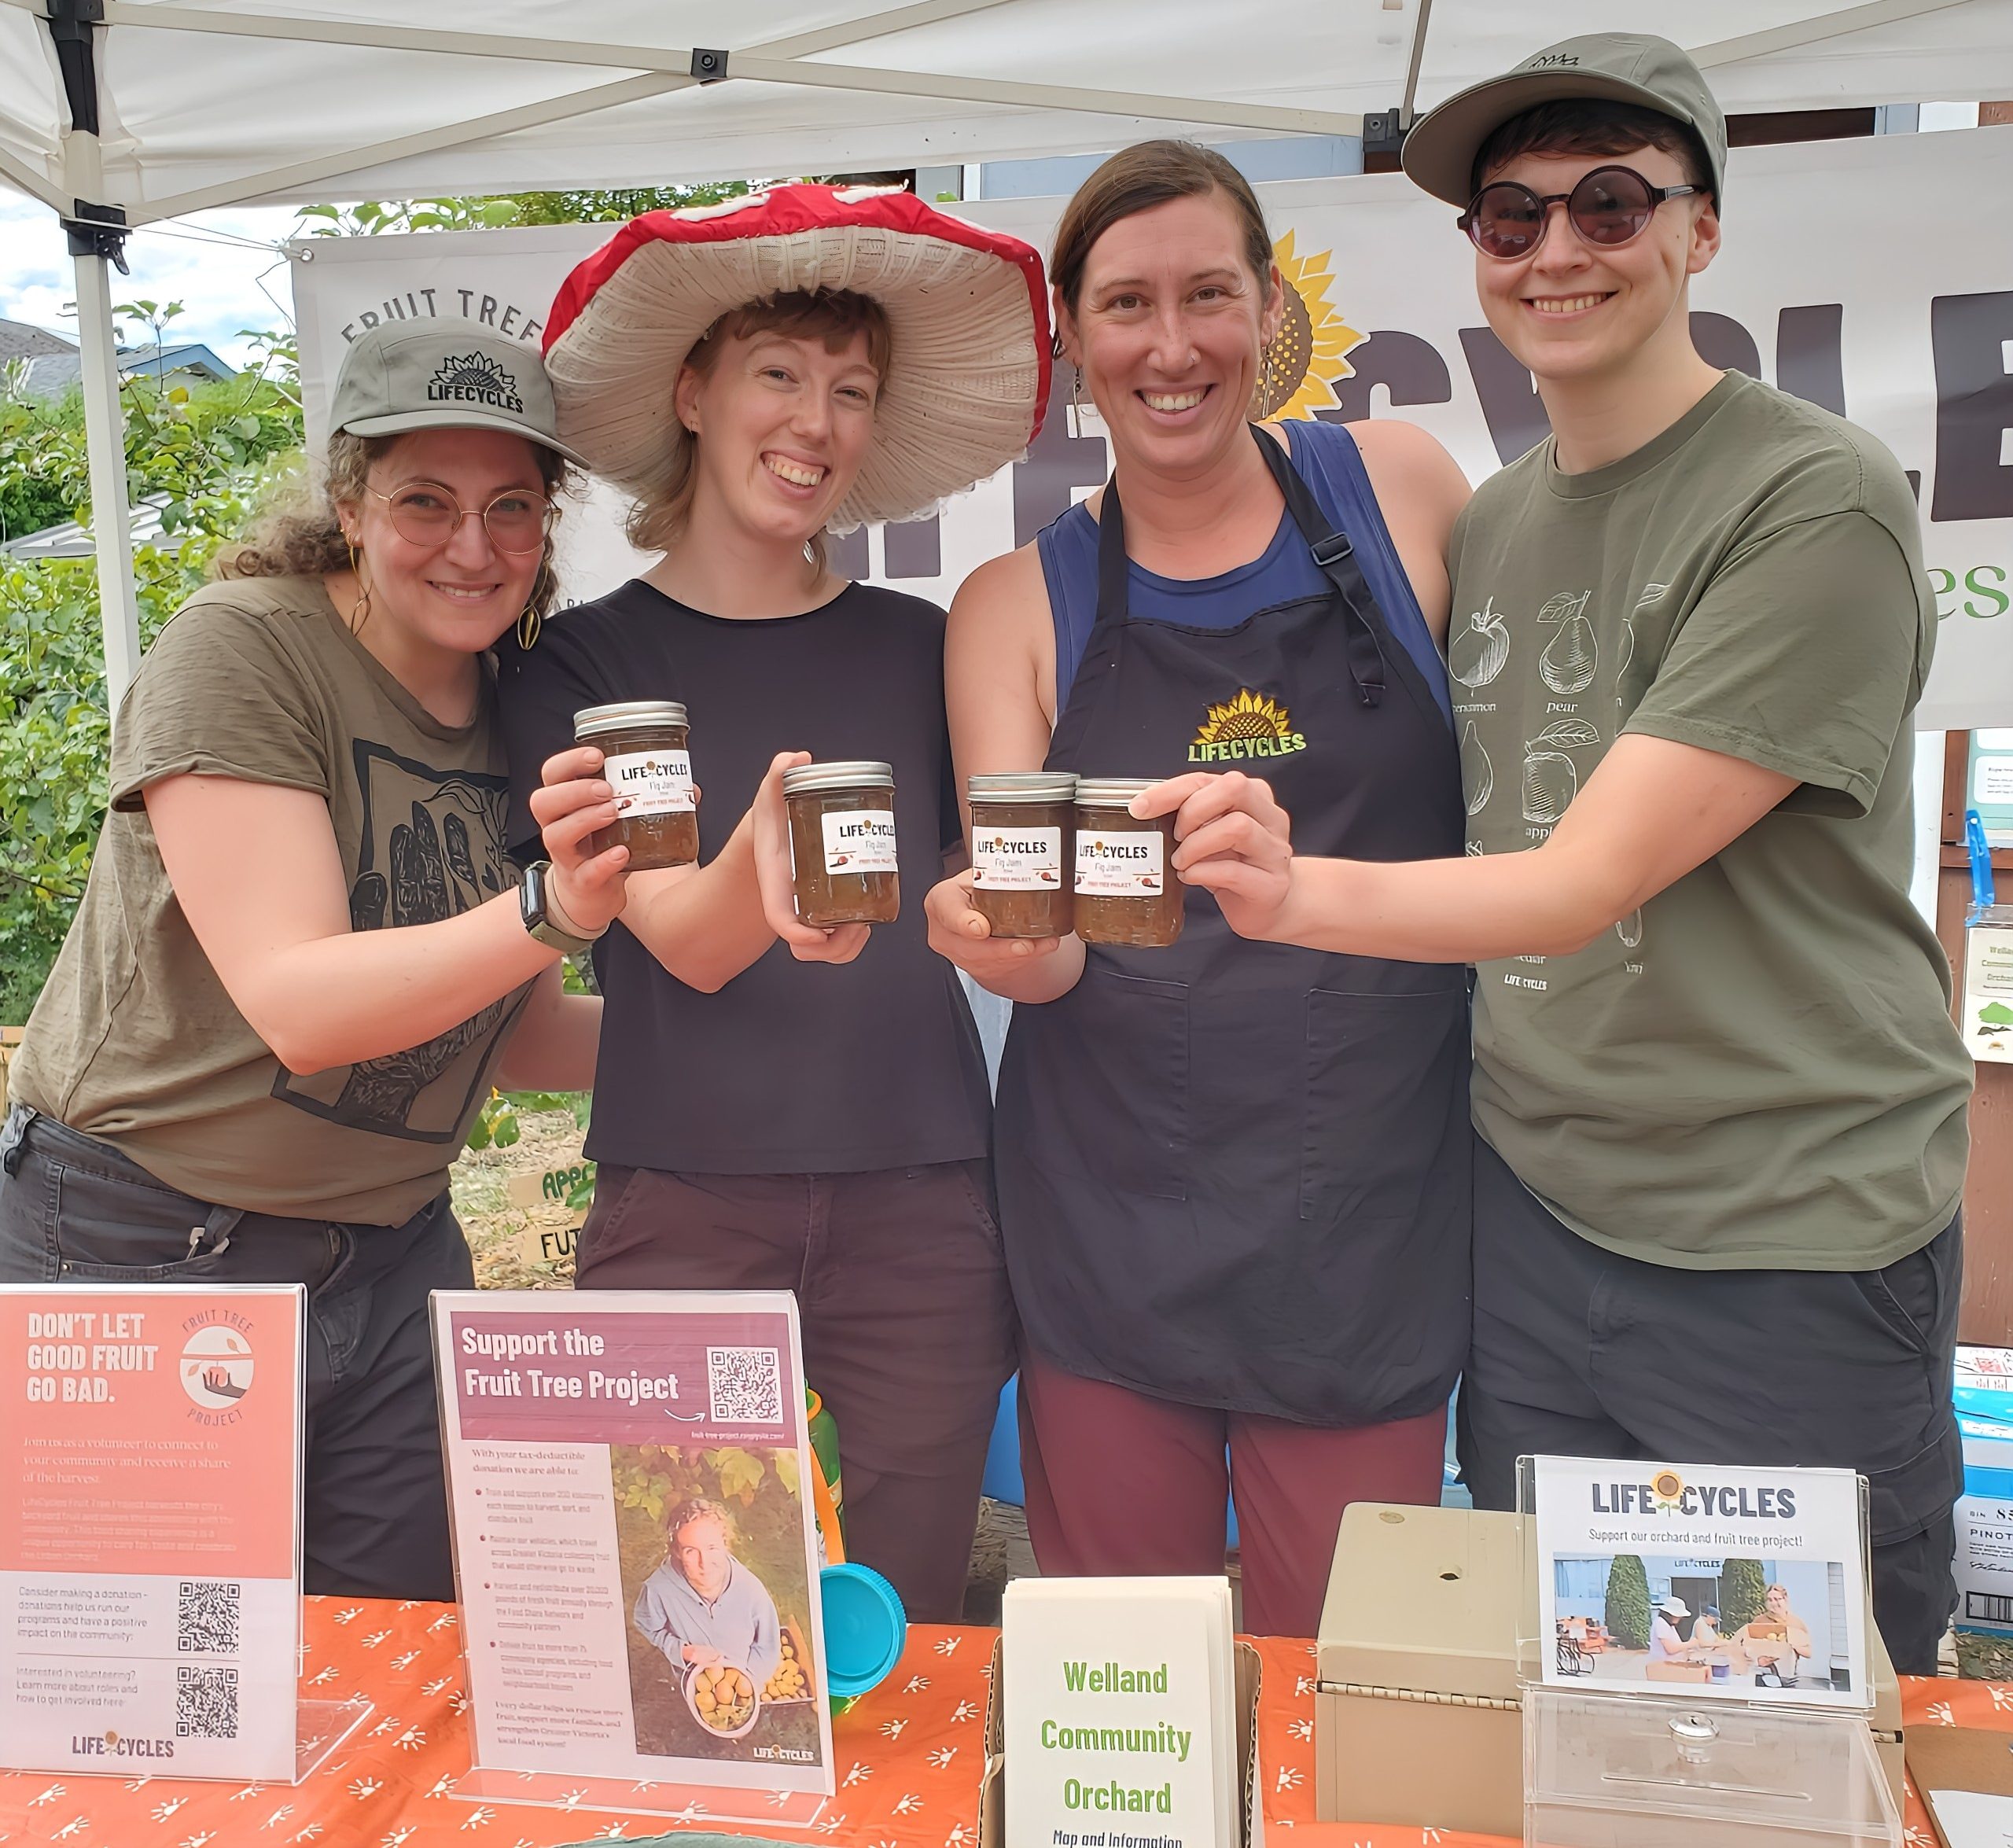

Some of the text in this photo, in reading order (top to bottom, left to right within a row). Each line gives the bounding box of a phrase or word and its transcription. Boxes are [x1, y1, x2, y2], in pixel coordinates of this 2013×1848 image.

[428, 385, 524, 415] LIFECYCLES
[1545, 701, 1578, 713] pear
[1187, 733, 1307, 762] LIFECYCLES
[621, 767, 648, 781] LIFE
[839, 825, 865, 837] LIFE
[1525, 826, 1552, 840] appl
[1003, 841, 1047, 853] CYCLES
[1102, 846, 1148, 859] CYCLES
[28, 1313, 145, 1338] DON'T LET
[182, 1309, 254, 1333] FRUIT TREE
[462, 1327, 605, 1360] Support the
[27, 1345, 159, 1371] GOOD FRUIT
[27, 1376, 116, 1403] GO BAD.
[465, 1368, 679, 1407] Fruit Tree Project
[186, 1408, 243, 1426] PROJECT
[86, 1438, 142, 1449] volunteer
[156, 1441, 205, 1451] connect
[206, 1441, 219, 1450] to
[120, 1456, 142, 1468] and
[197, 1458, 232, 1469] share
[472, 1449, 495, 1457] With
[495, 1450, 517, 1460] your
[37, 1471, 56, 1484] the
[473, 1464, 513, 1474] donation
[1592, 1482, 1797, 1519] LIFE CYCLES
[1588, 1529, 1803, 1548] Support our orchard and fruit tree project!
[1970, 1529, 2013, 1541] PINOT
[19, 1587, 58, 1596] Consider
[60, 1588, 93, 1599] making
[101, 1589, 142, 1599] donation
[1063, 1662, 1168, 1694] Welland
[72, 1736, 175, 1758] LIFE CYCLES
[1041, 1720, 1192, 1762] Community
[1064, 1779, 1172, 1814] Orchard
[1053, 1829, 1183, 1848] Map and Information
